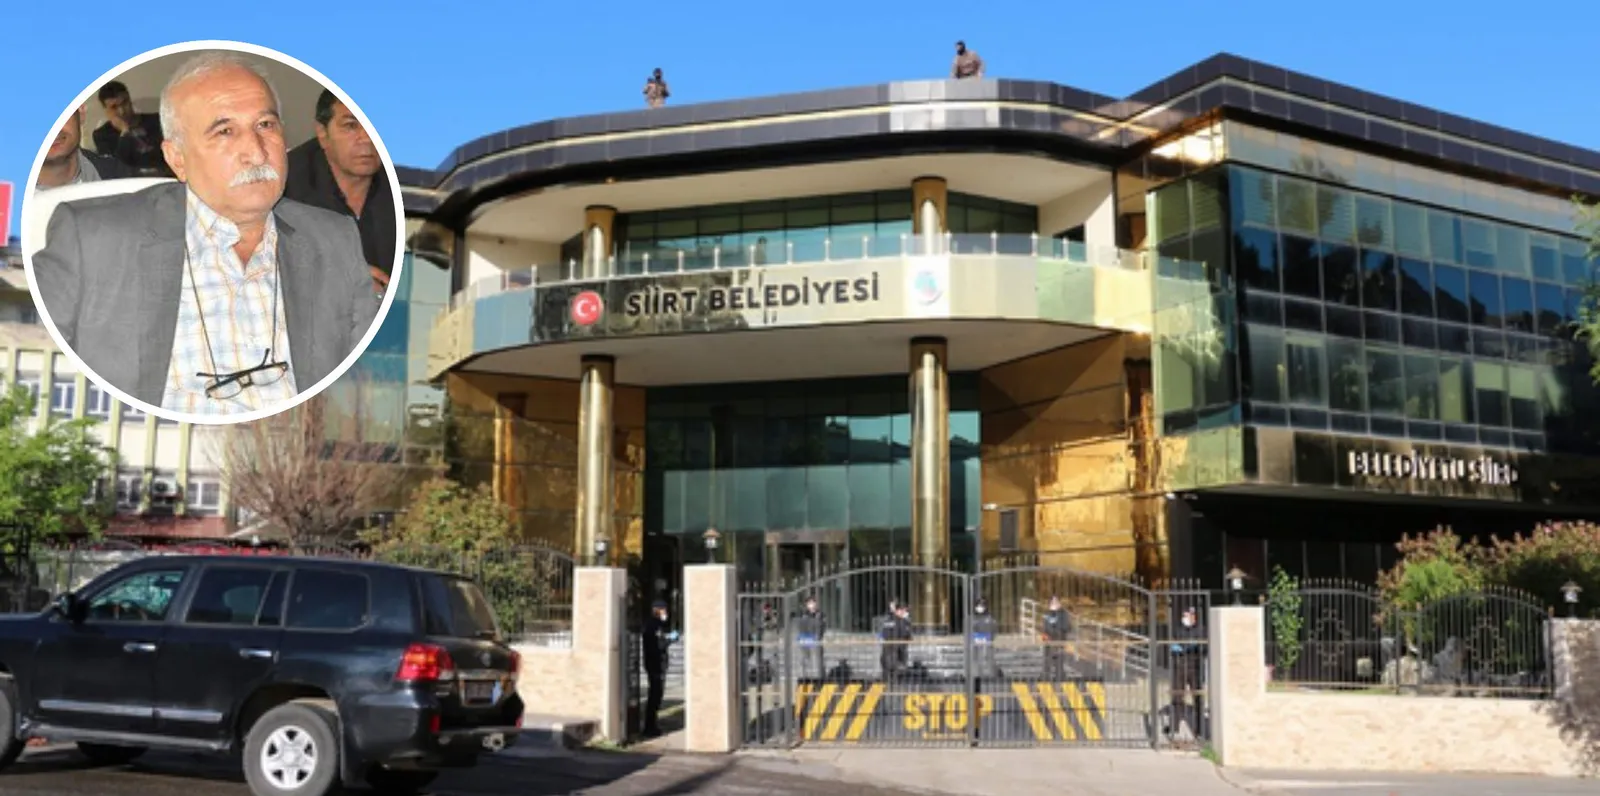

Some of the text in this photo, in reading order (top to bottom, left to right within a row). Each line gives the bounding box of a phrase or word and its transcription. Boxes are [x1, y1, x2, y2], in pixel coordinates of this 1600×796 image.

[626, 271, 879, 316] SİİRT BELEDİYESİ
[904, 693, 993, 731] STOP
